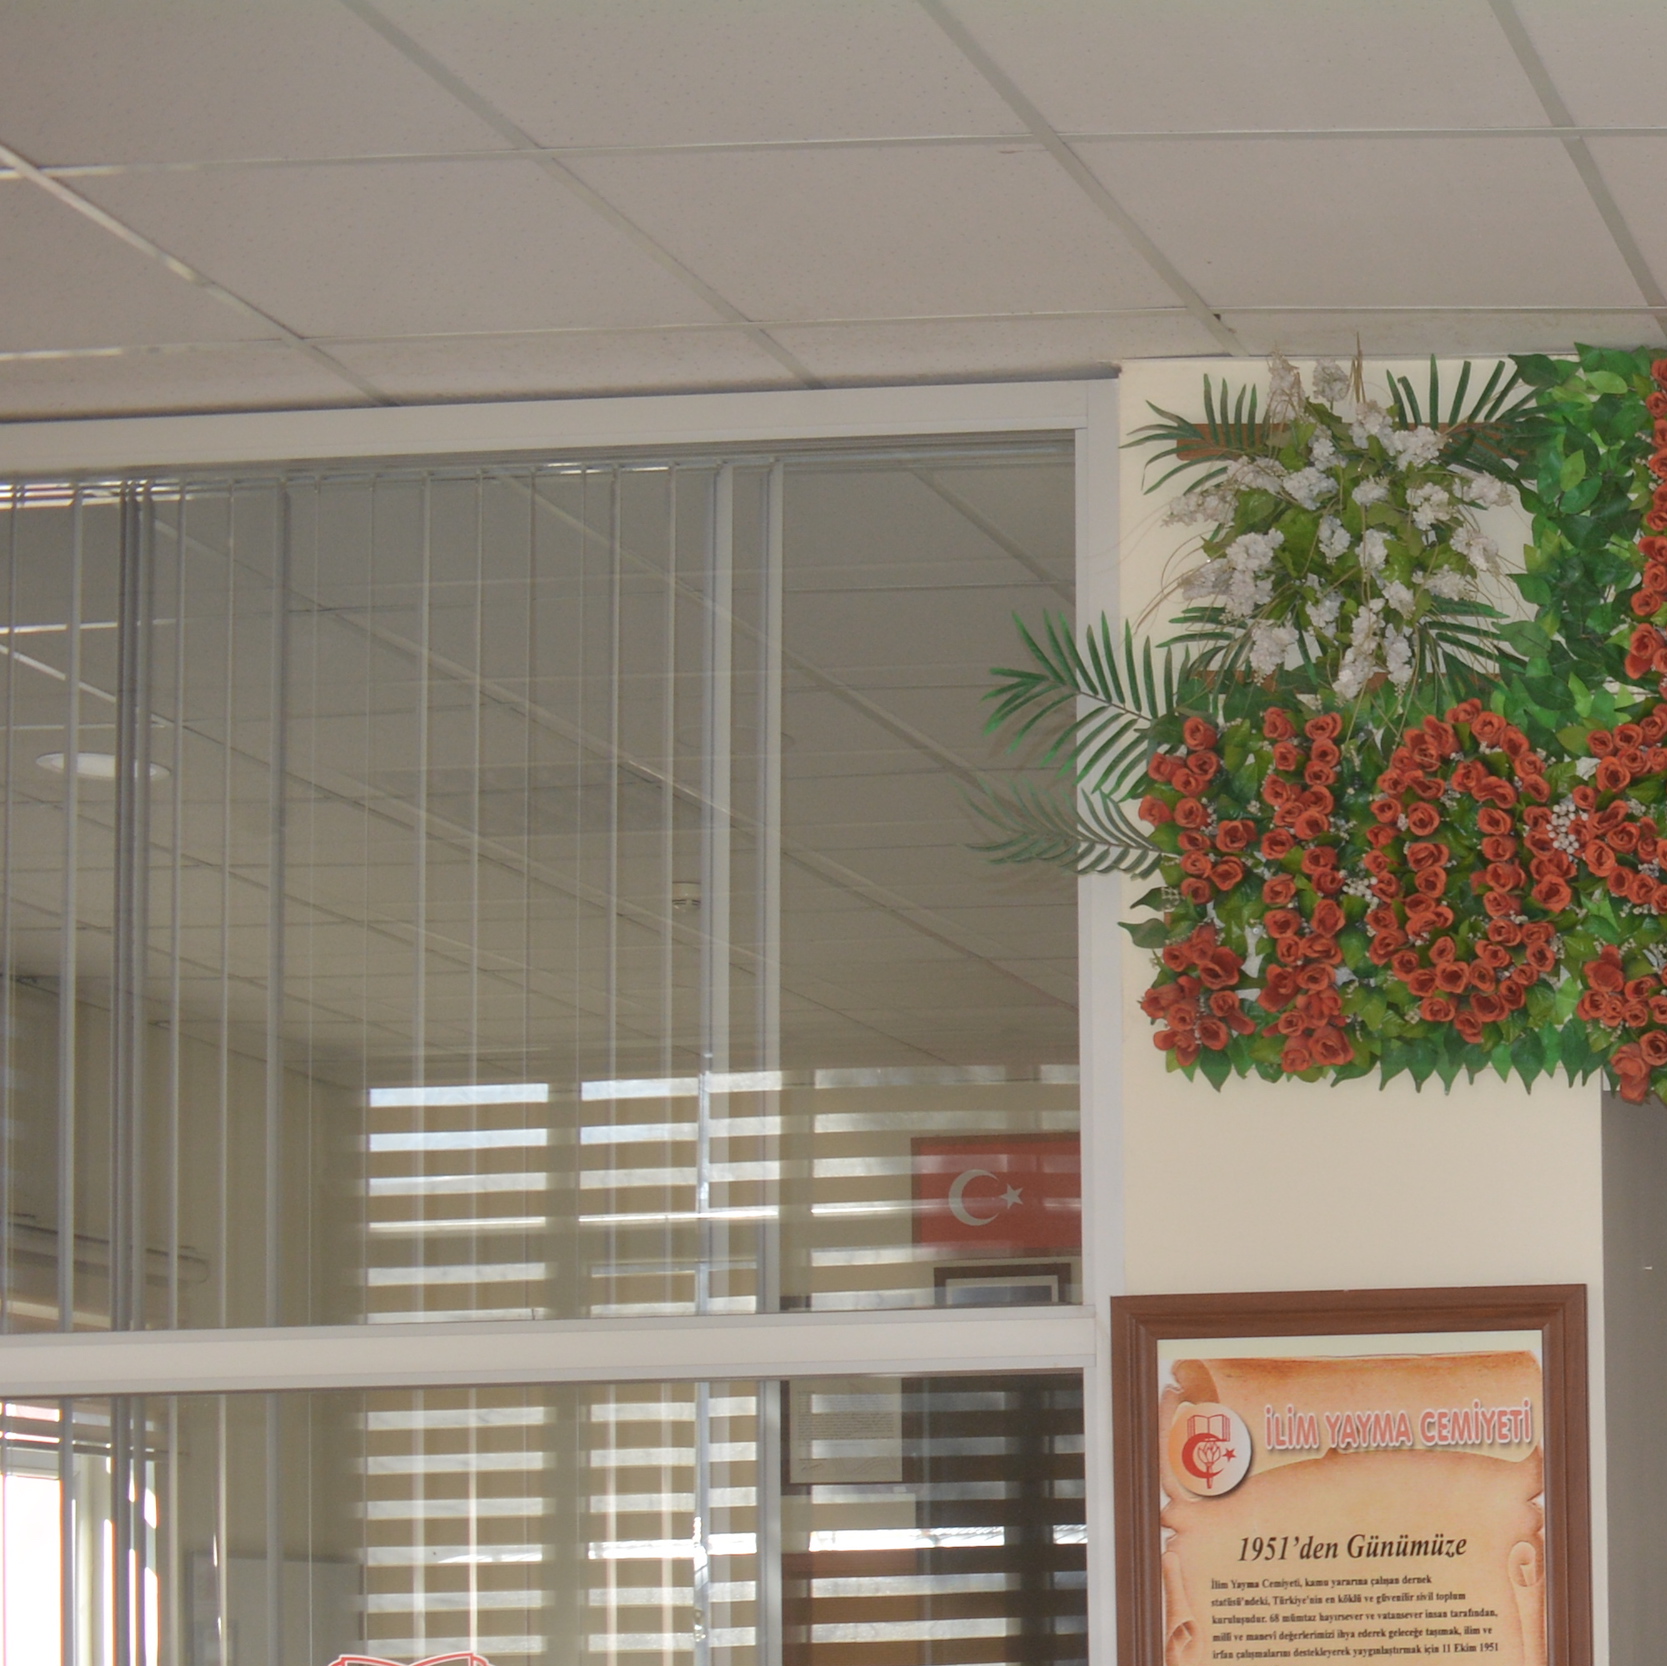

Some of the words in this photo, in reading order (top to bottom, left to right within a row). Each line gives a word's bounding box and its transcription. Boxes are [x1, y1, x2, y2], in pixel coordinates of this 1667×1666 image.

[1265, 1404, 1319, 1450] İLİM
[1325, 1409, 1413, 1449] YAYMA
[1419, 1398, 1533, 1446] CEMİYETİ
[1237, 1534, 1338, 1562] 1951'den
[1347, 1531, 1467, 1561] Günümüze
[1269, 1614, 1280, 1623] 68
